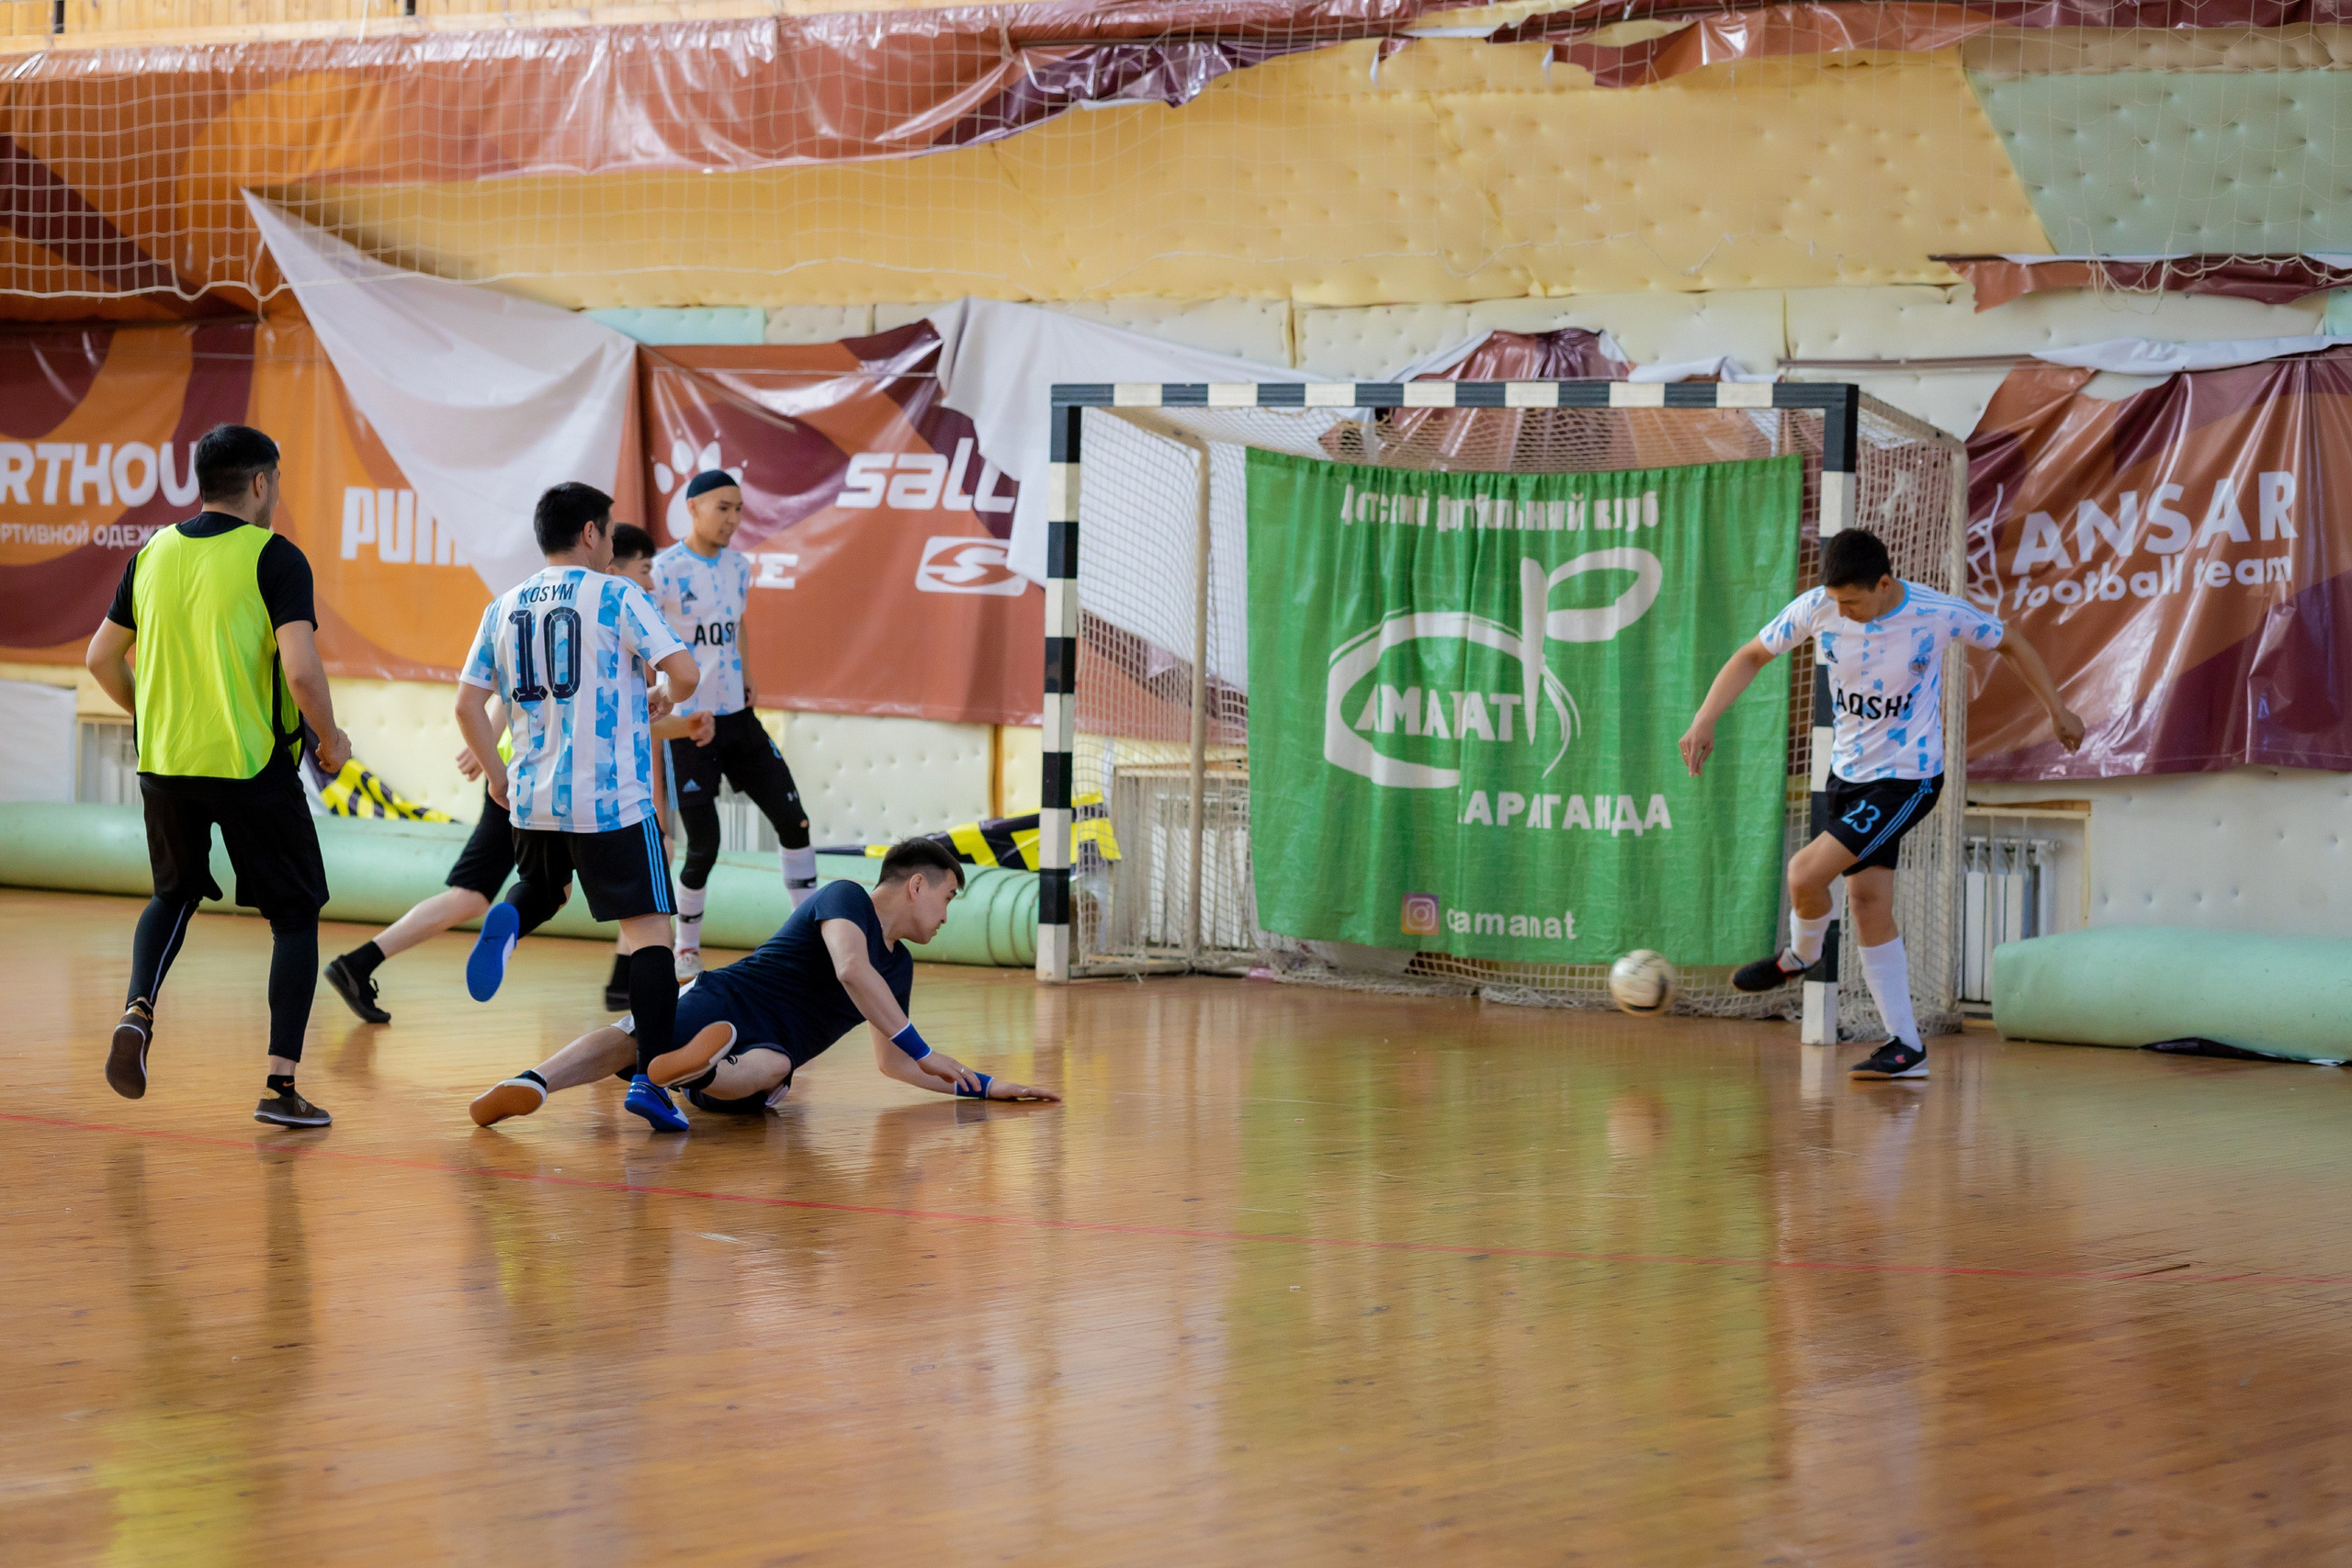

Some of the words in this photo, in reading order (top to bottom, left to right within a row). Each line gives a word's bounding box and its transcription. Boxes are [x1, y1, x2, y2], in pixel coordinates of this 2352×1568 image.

[0, 441, 199, 507] RTHOU
[93, 525, 165, 549] ОДЕЖ
[2011, 470, 2299, 576] ANSAR
[519, 583, 574, 604] KOSYM
[2012, 553, 2184, 611] football
[2193, 553, 2292, 588] team
[508, 606, 582, 703] 10
[1457, 789, 1673, 837] АРАГАНДА
[1841, 799, 1881, 833] 23
